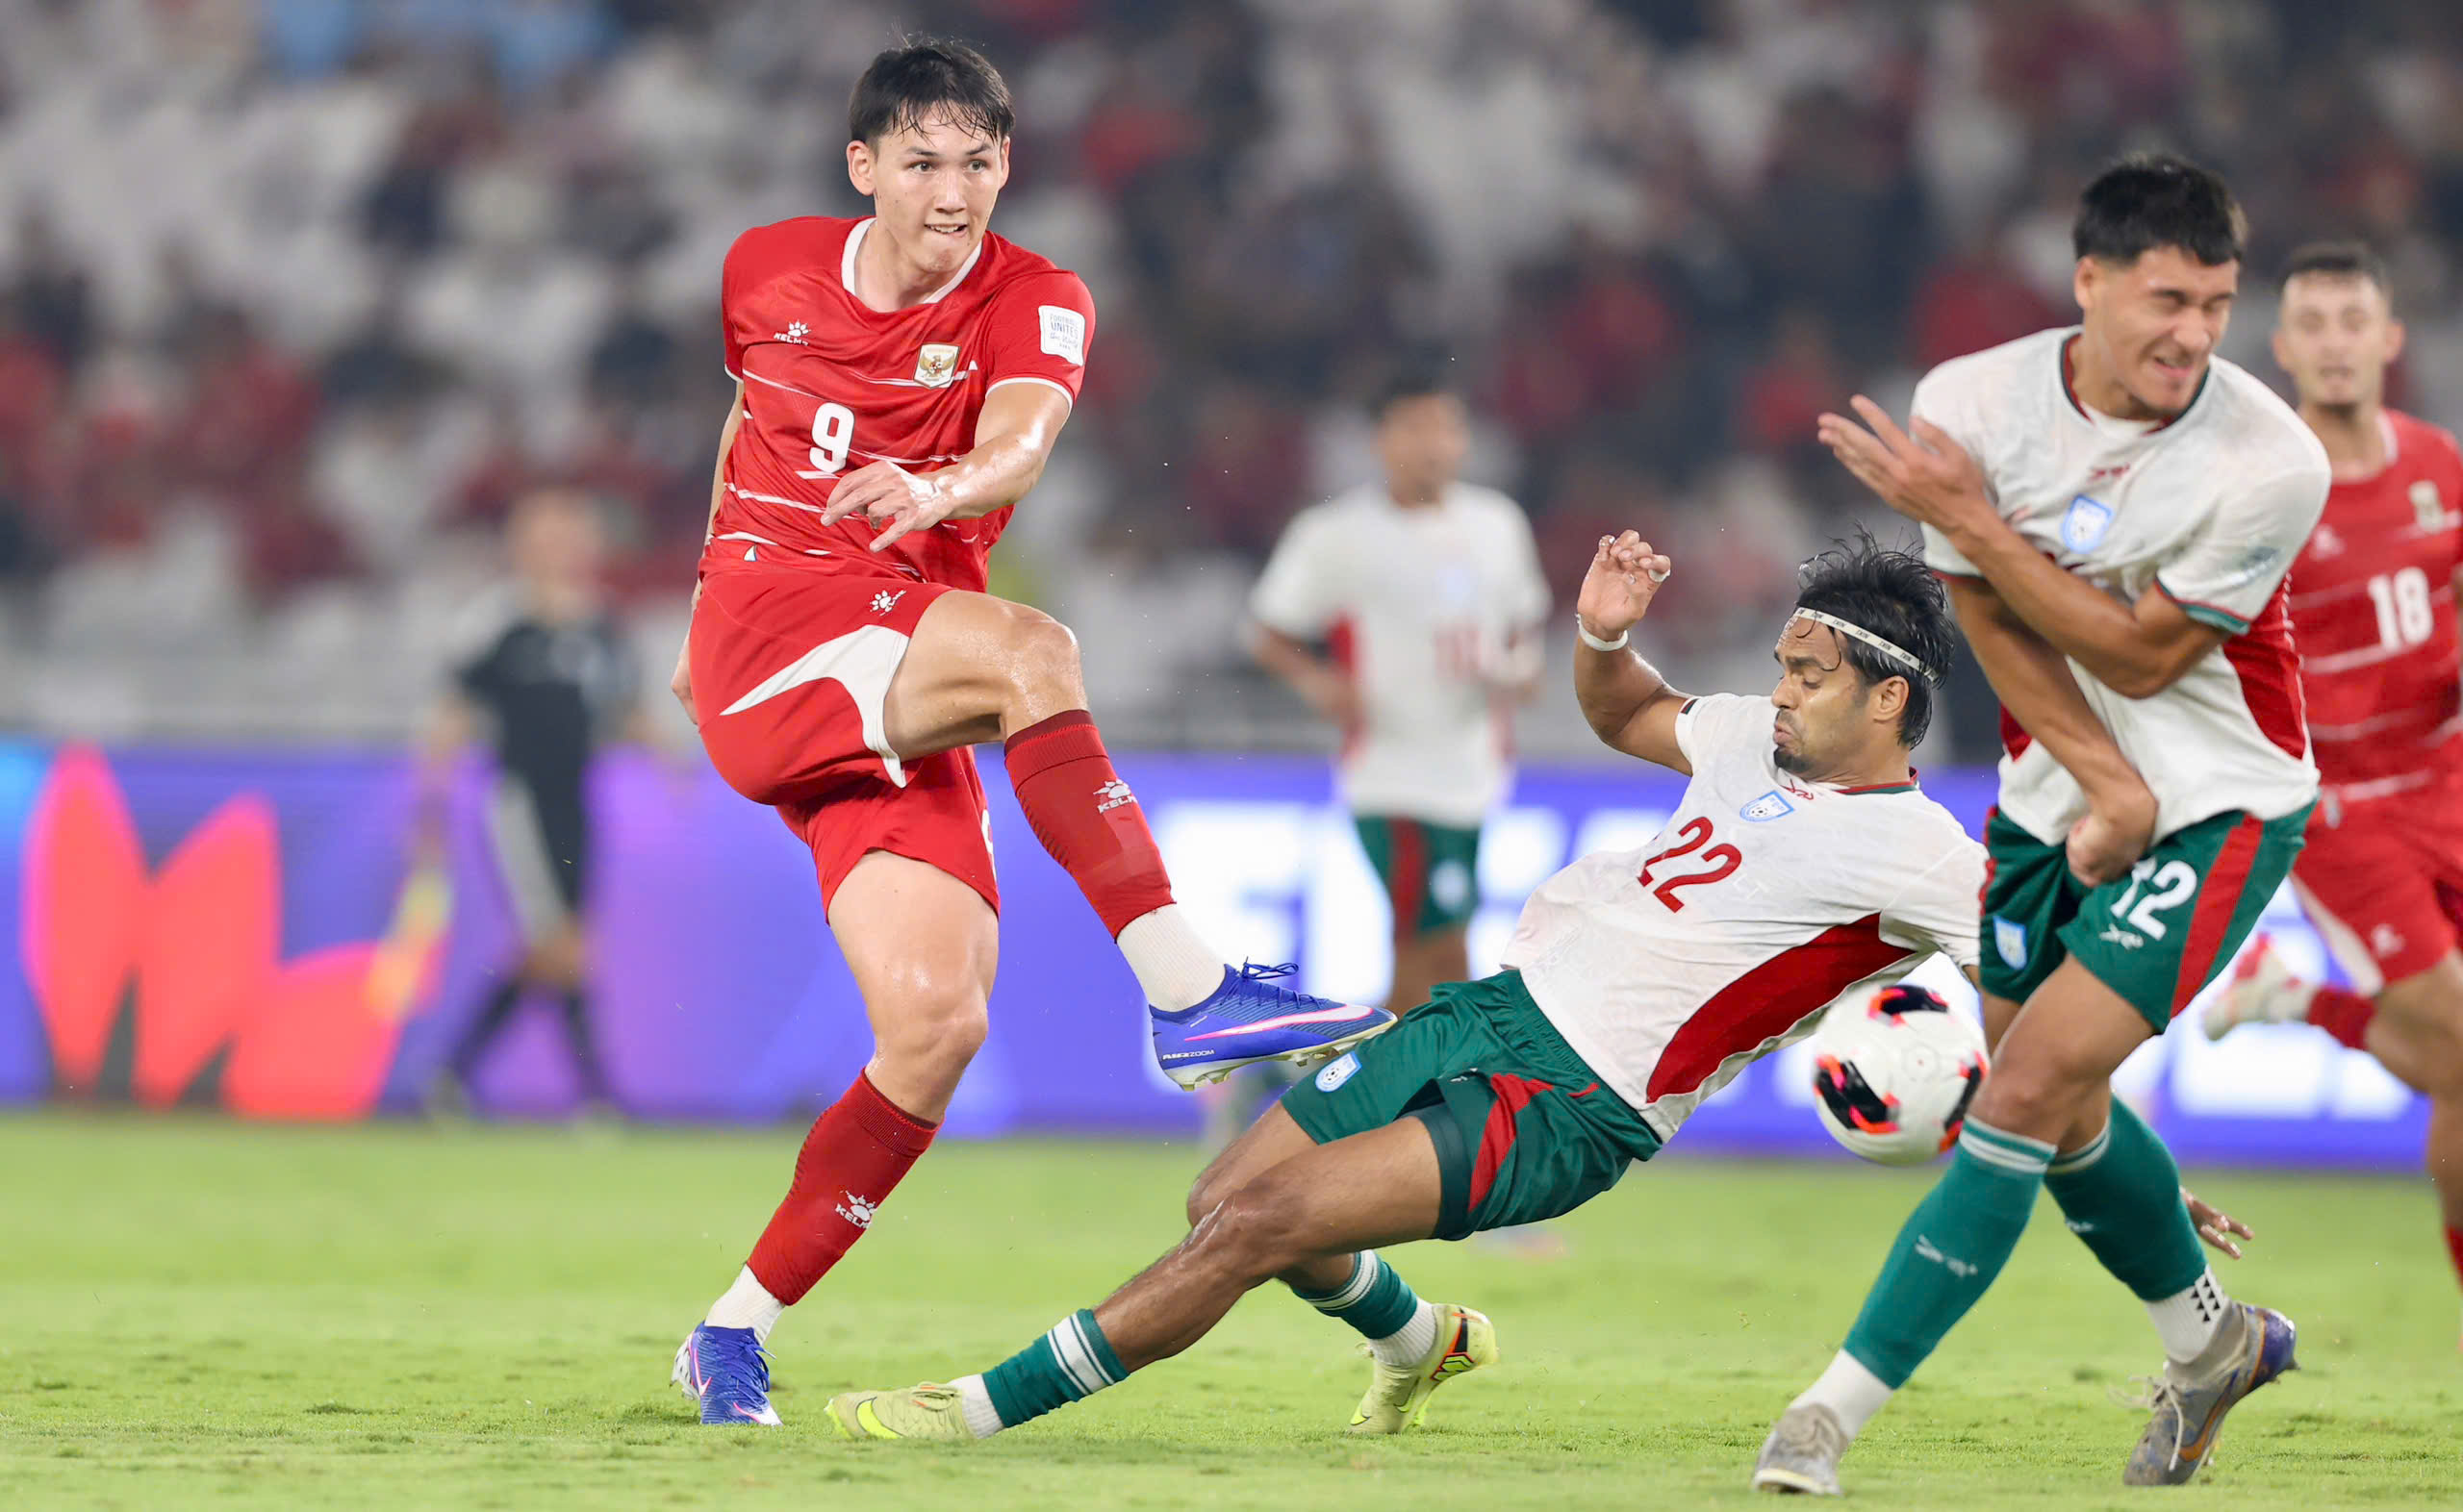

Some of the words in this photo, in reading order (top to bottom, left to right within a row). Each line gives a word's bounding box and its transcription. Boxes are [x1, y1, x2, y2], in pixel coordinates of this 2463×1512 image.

[809, 402, 855, 473] 9
[2368, 567, 2435, 650] 18
[1637, 816, 1742, 914] 22
[2109, 856, 2197, 941] 12
